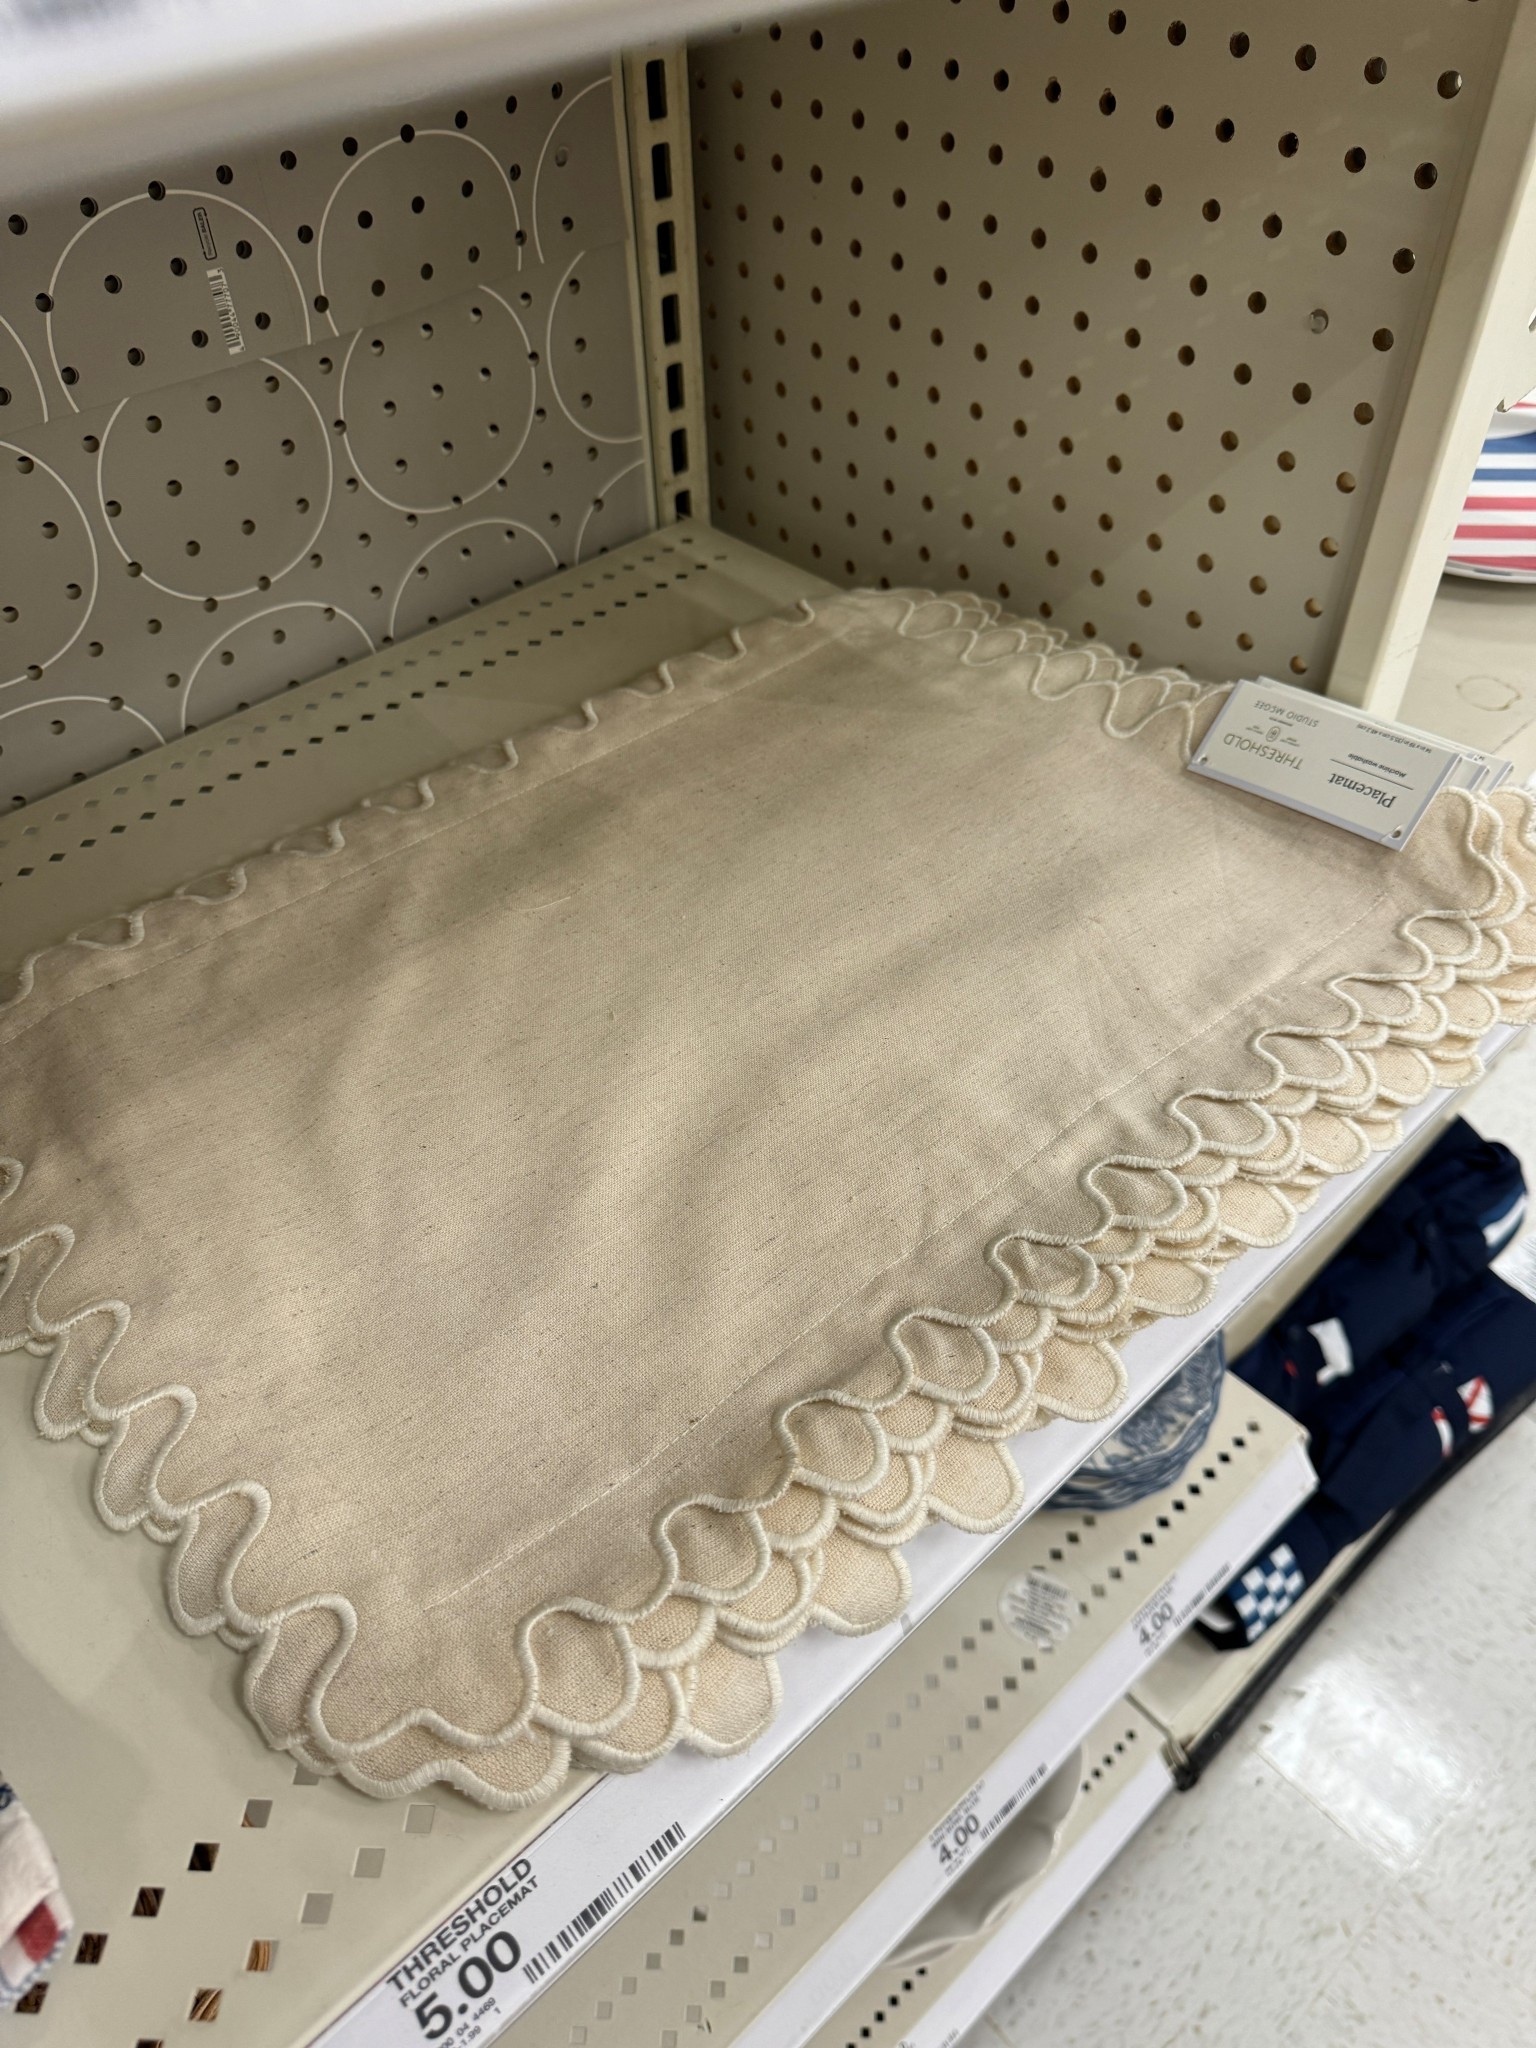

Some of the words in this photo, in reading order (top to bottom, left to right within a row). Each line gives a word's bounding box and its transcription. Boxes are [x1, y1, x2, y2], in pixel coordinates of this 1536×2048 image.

[1286, 713, 1319, 728] STUDIO
[1223, 732, 1304, 770] THRESHOLD
[1347, 753, 1378, 767] washable
[1378, 764, 1407, 778] Machine
[1328, 773, 1398, 808] Placemat
[1139, 1602, 1173, 1644] 4.00
[939, 1814, 979, 1863] 4.00
[386, 1858, 532, 1991] THRESHOLD
[399, 1953, 461, 2008] FLORAL
[460, 1875, 539, 1952] PLACEMAT
[415, 1931, 521, 2040] 5.00
[456, 2021, 470, 2036] 04
[473, 1996, 496, 2021] 4469
